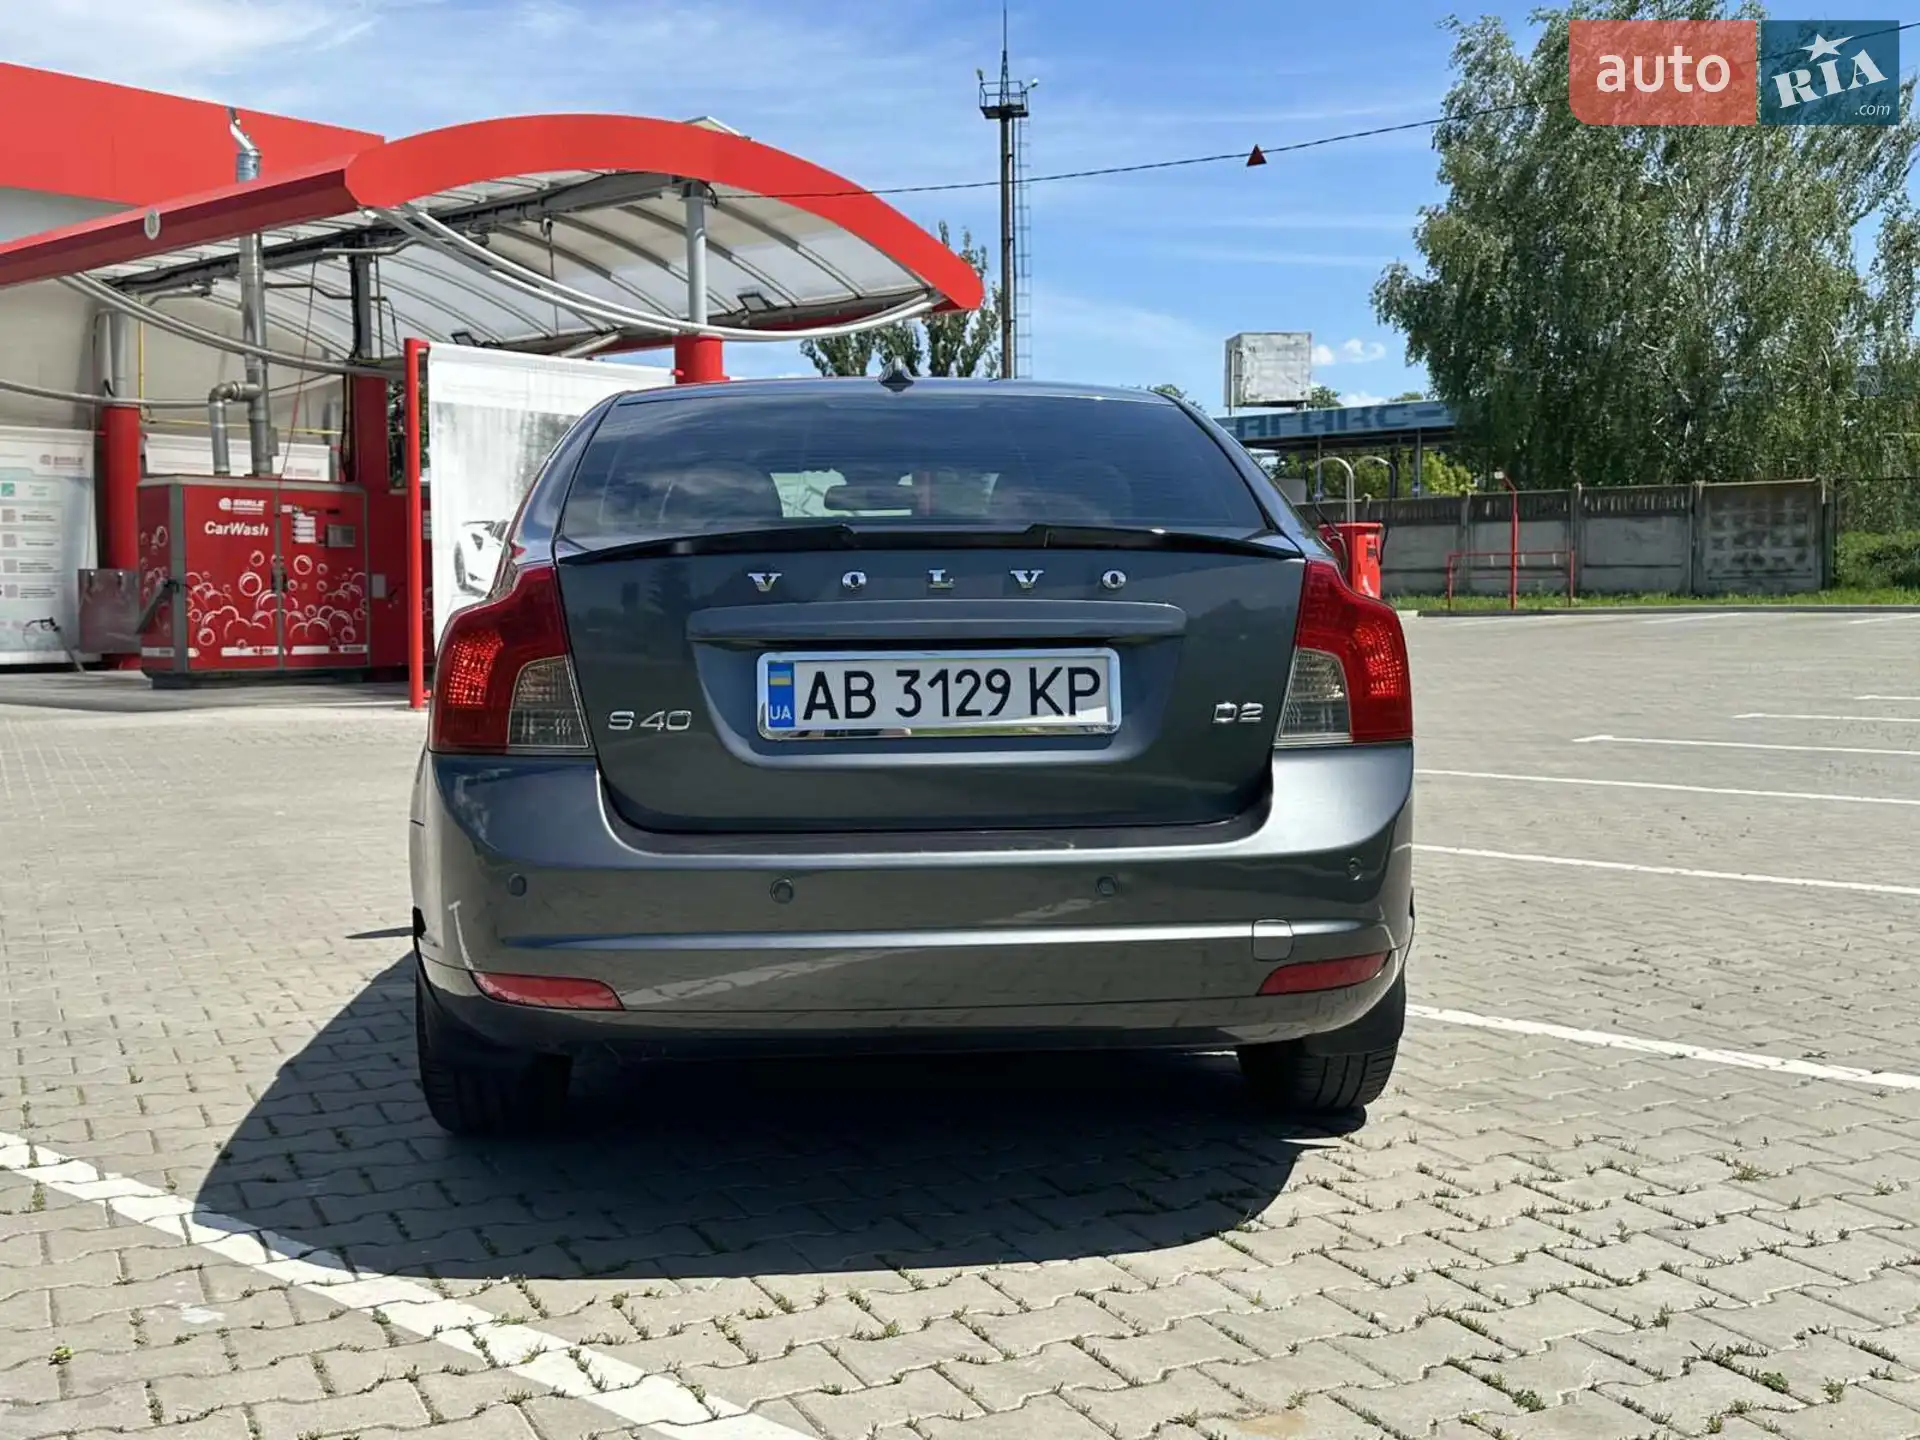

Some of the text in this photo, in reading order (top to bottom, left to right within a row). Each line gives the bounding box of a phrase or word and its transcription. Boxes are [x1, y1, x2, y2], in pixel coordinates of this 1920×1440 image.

[204, 521, 269, 537] CarWash
[748, 569, 1127, 592] VOLVO
[803, 666, 1101, 720] AB 3129 KP
[769, 704, 793, 721] UA
[1212, 702, 1264, 723] D2
